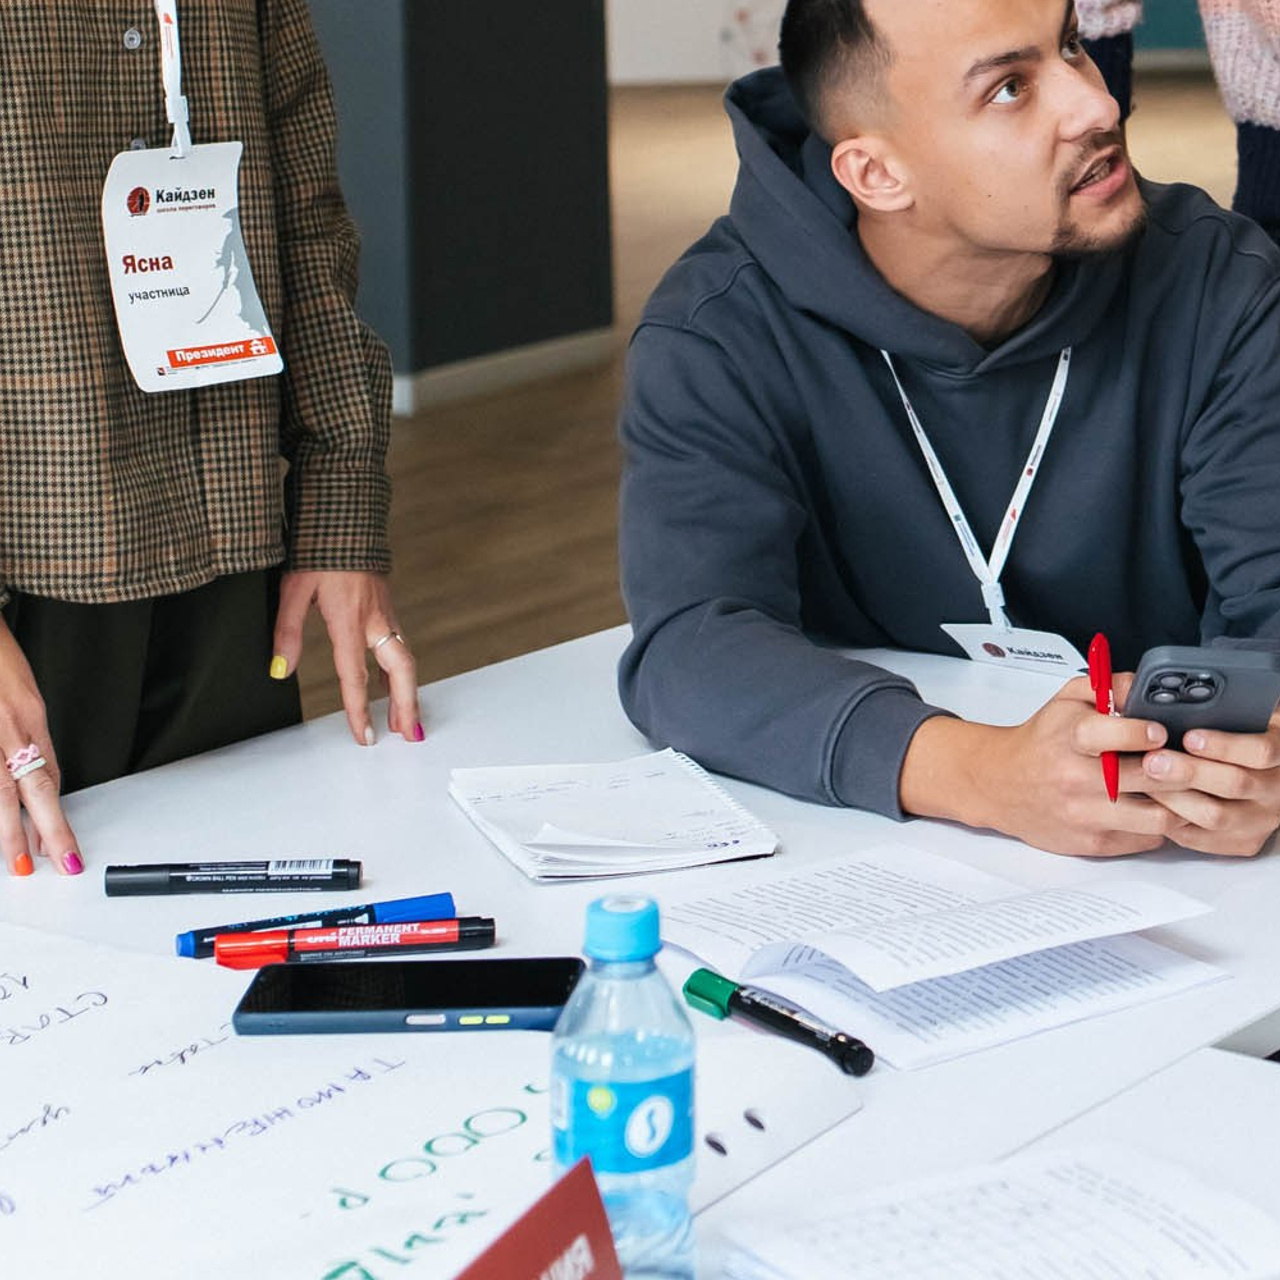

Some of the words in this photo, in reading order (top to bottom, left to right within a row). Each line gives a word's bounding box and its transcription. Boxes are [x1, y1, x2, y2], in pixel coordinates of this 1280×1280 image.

[155, 187, 215, 203] Кайдзен
[122, 254, 174, 274] Ясна
[128, 285, 191, 304] участница
[174, 344, 245, 362] Президент
[338, 923, 420, 936] PERMANENT
[338, 934, 400, 947] MARKER
